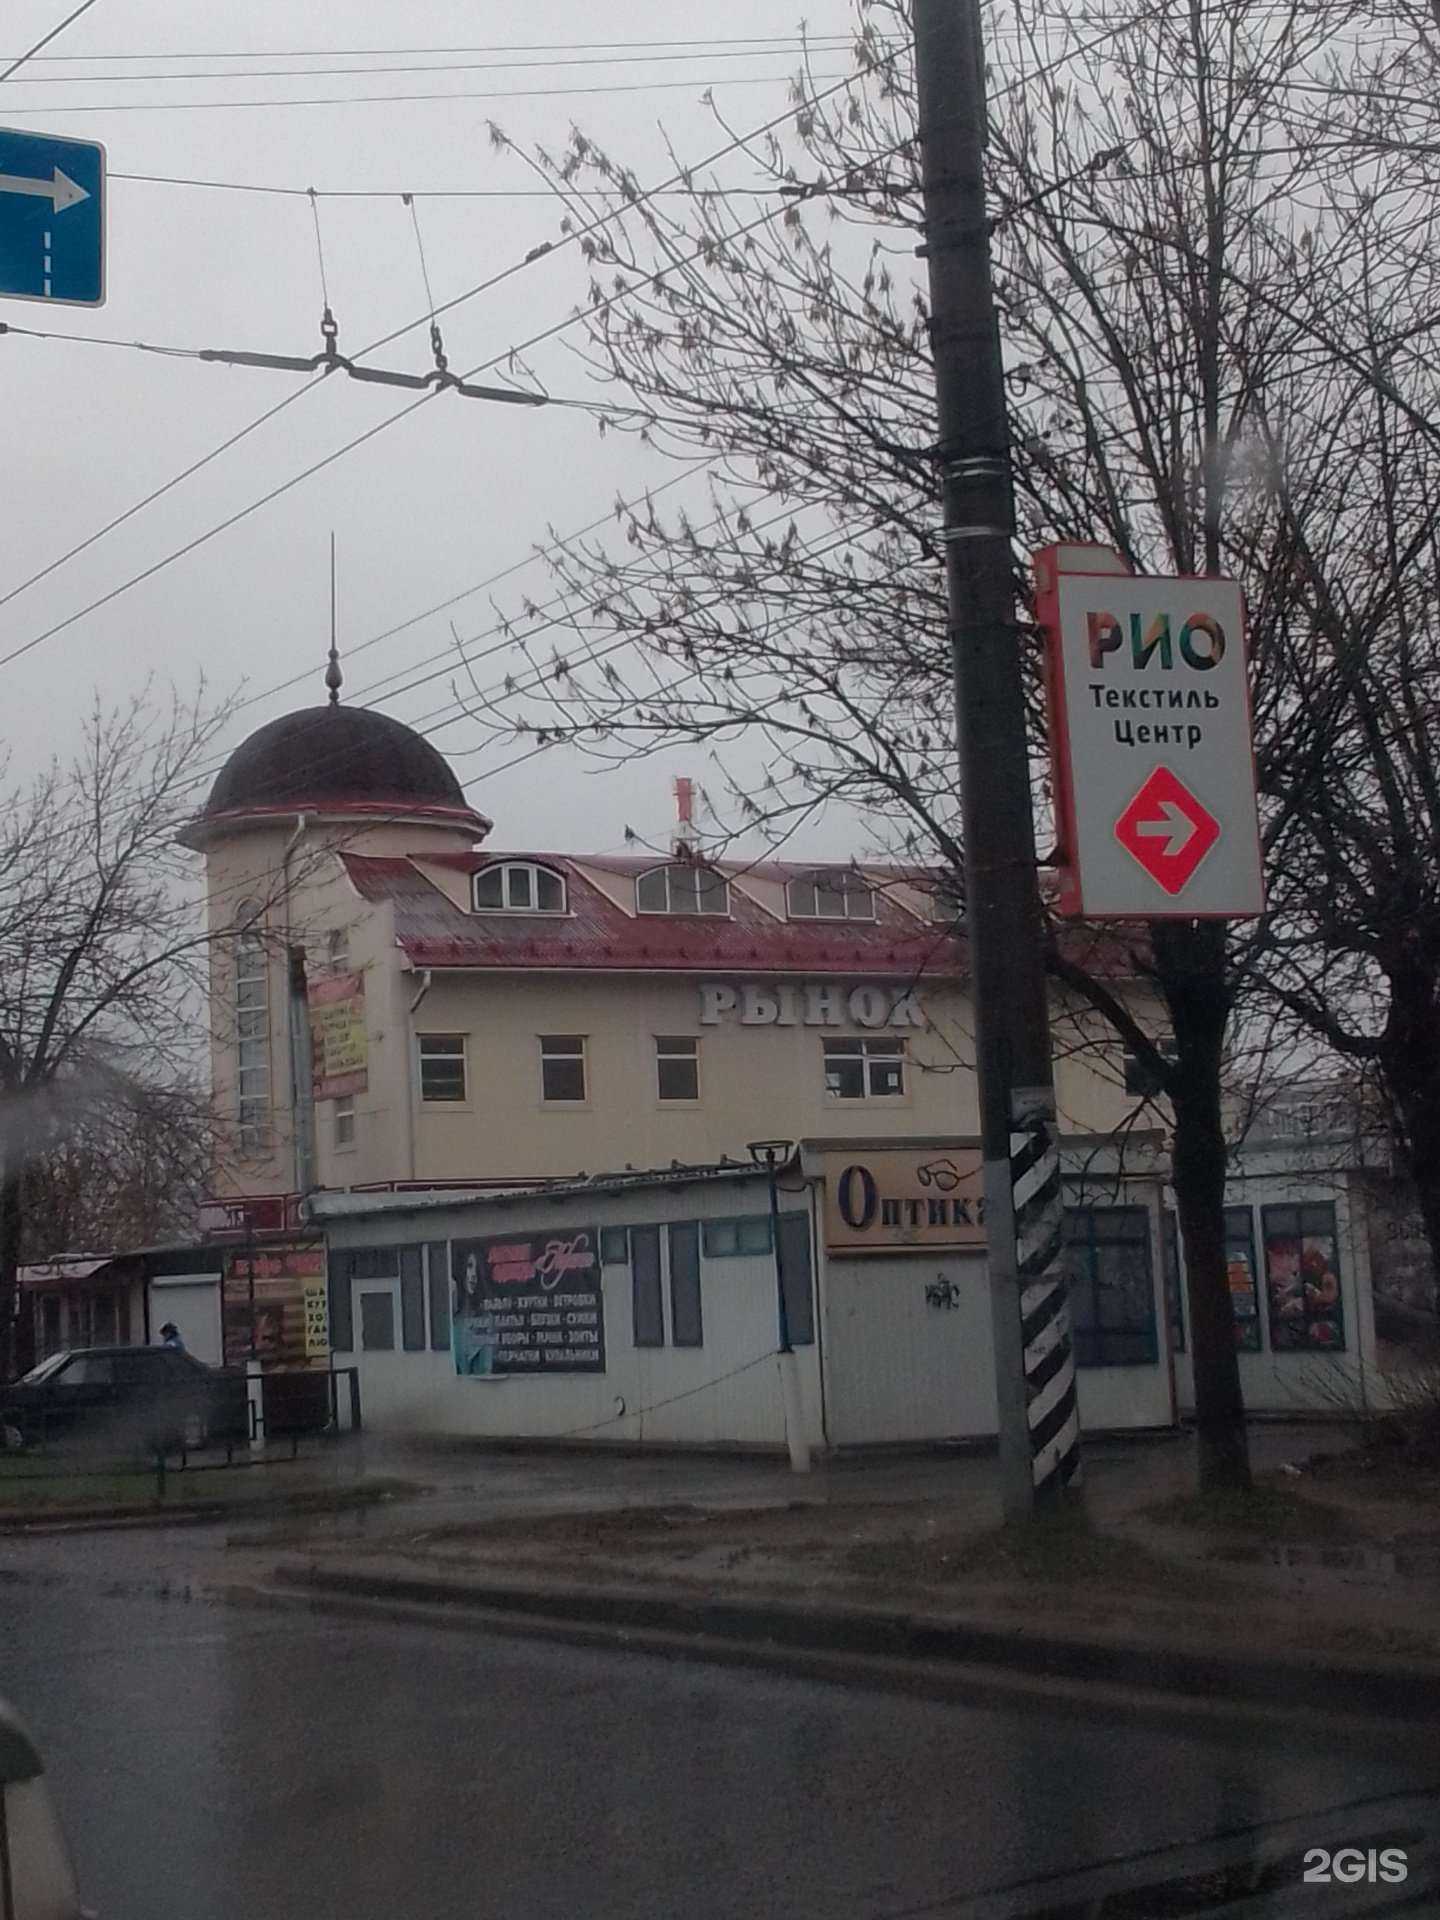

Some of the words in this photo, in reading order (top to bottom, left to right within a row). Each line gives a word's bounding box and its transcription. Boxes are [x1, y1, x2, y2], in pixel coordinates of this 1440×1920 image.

[1086, 611, 1226, 671] РИО
[1088, 684, 1220, 710] Текстиль
[1113, 719, 1202, 749] Центр
[700, 984, 926, 1029] РЫНОК
